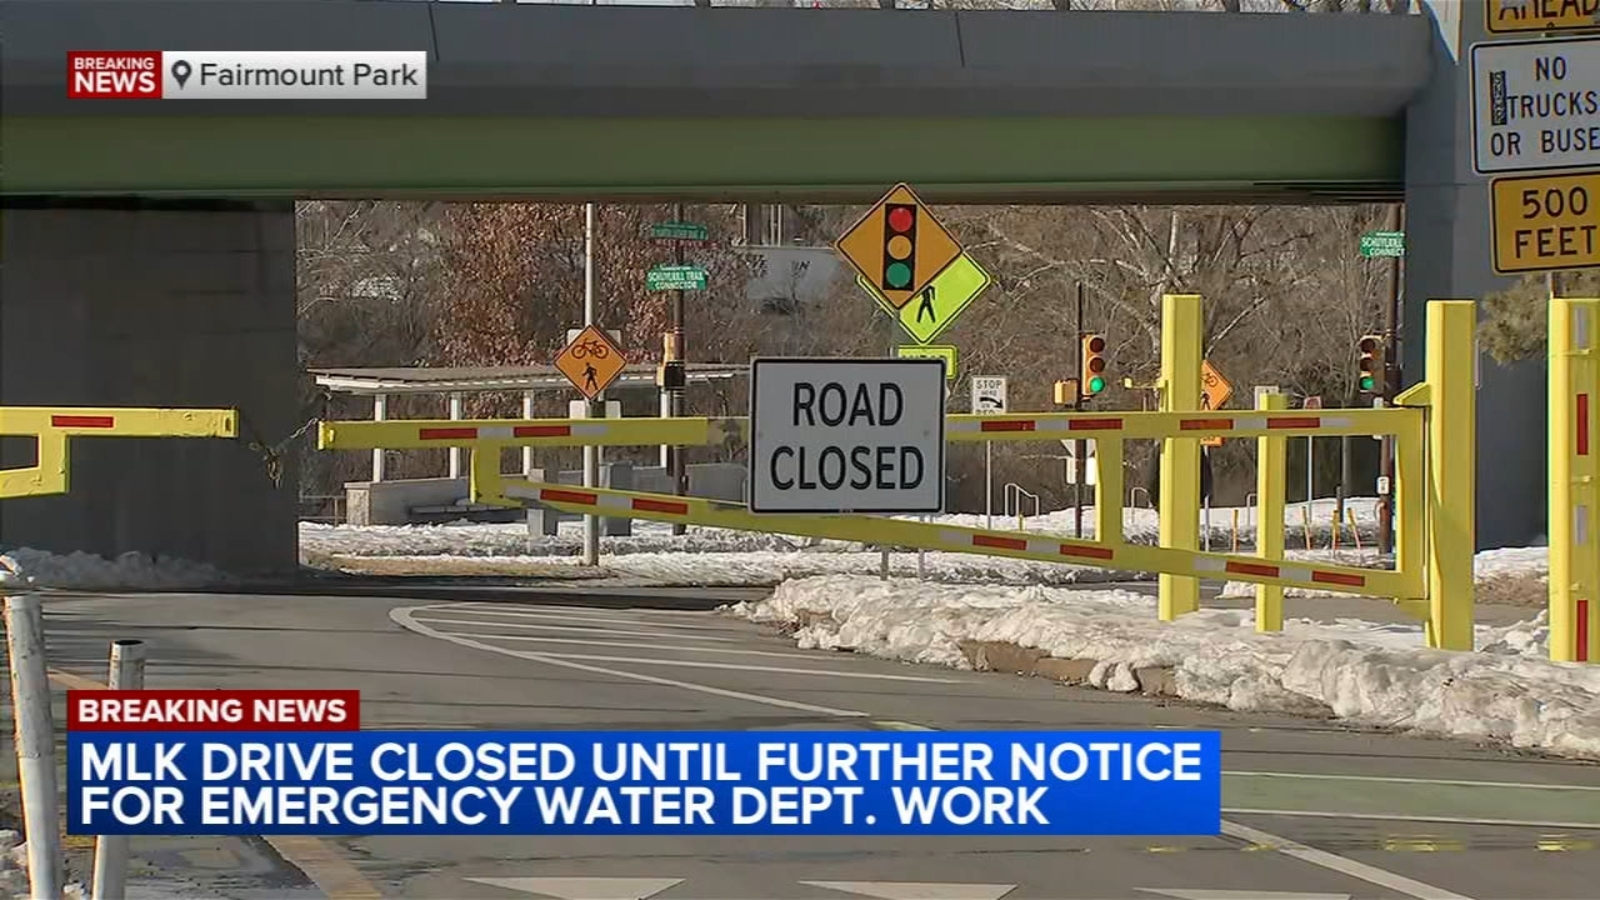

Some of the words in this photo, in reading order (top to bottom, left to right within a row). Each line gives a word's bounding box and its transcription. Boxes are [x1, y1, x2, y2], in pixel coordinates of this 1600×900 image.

[1499, 0, 1599, 20] AHEAD
[1536, 57, 1566, 81] NO
[1506, 91, 1598, 119] TRUCKS
[1491, 132, 1521, 156] OR
[1541, 128, 1600, 153] BUSE
[1522, 187, 1588, 219] 500
[1515, 226, 1597, 259] FEET
[976, 380, 1002, 389] STOP
[793, 382, 903, 426] ROAD
[770, 446, 924, 490] CLOSED
